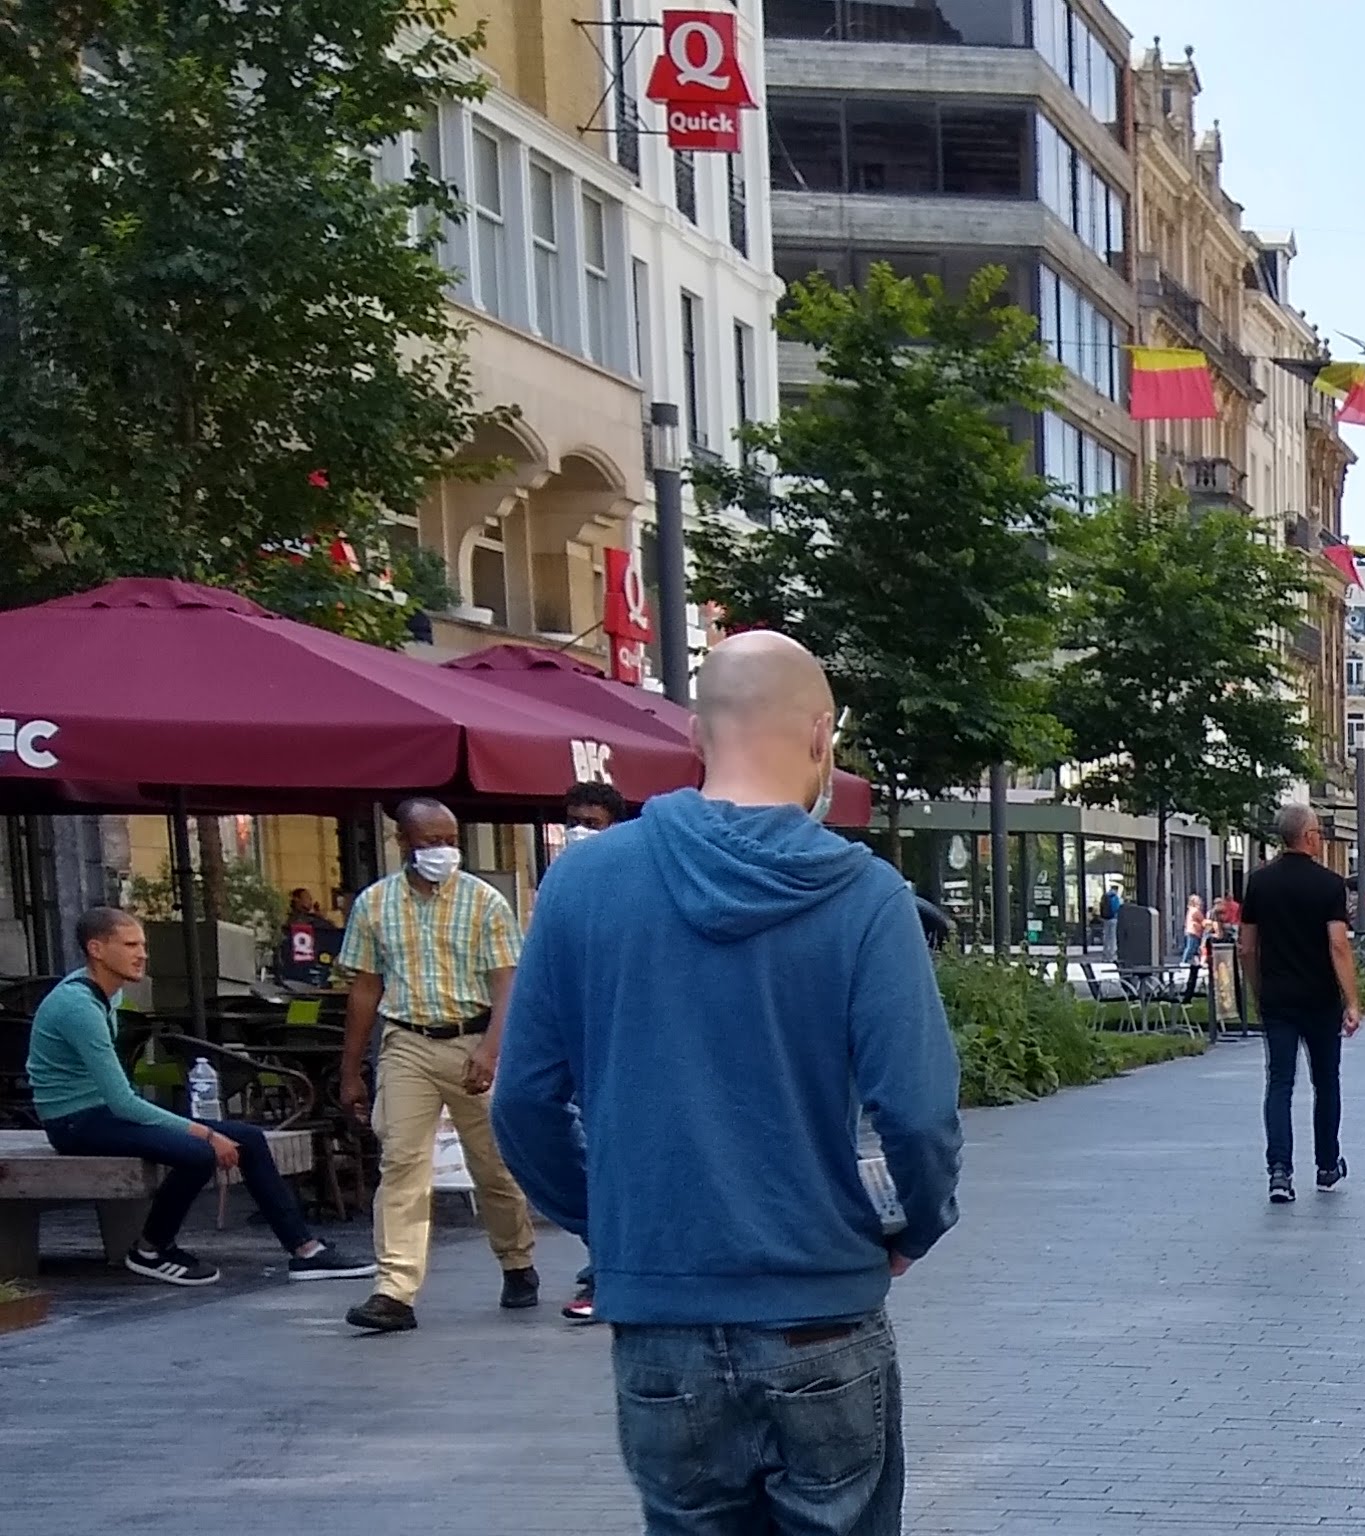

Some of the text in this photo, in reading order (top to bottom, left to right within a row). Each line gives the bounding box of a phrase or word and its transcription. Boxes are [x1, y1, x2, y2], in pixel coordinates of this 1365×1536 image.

[669, 21, 731, 91] Q
[669, 111, 735, 133] Quick
[624, 567, 649, 630] Q
